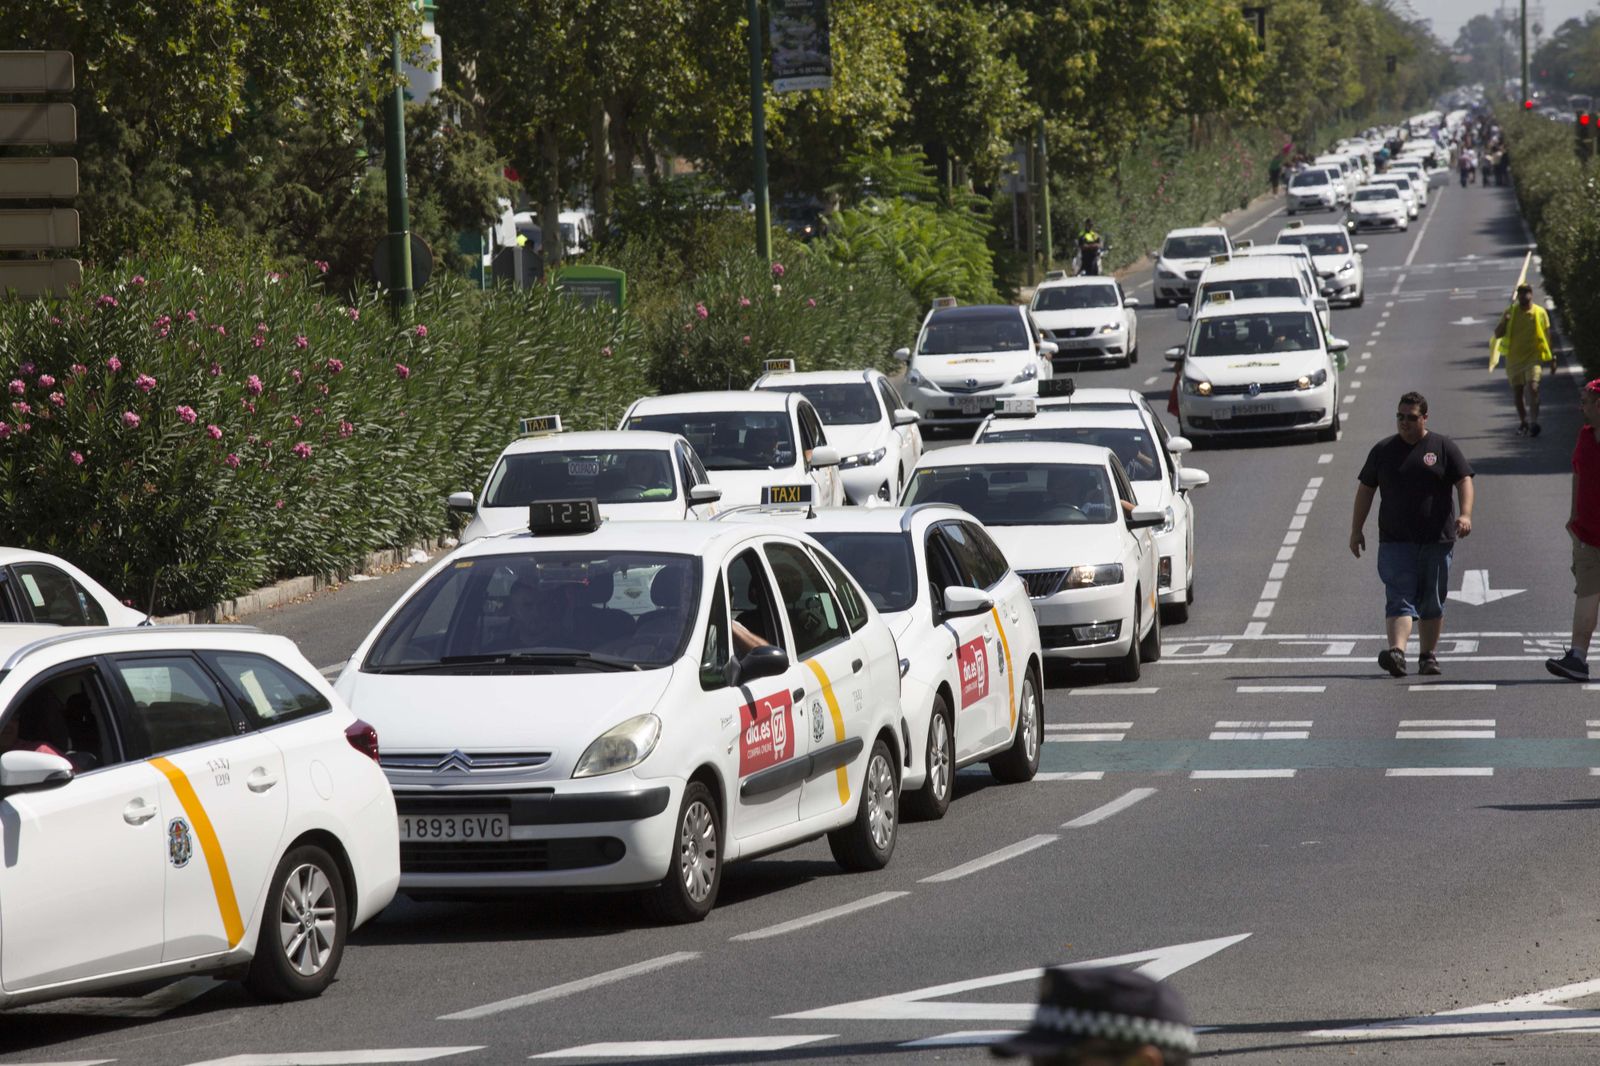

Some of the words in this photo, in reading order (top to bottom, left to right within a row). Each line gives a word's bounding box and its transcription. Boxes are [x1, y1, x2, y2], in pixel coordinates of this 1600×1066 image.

[527, 419, 548, 432] TAXI
[771, 486, 801, 503] TAXI
[547, 502, 591, 524] 123
[746, 719, 771, 746] dia.es
[206, 758, 230, 772] TAXI
[215, 772, 231, 787] 1219
[404, 818, 456, 838] 1893
[462, 818, 503, 838] GVG
